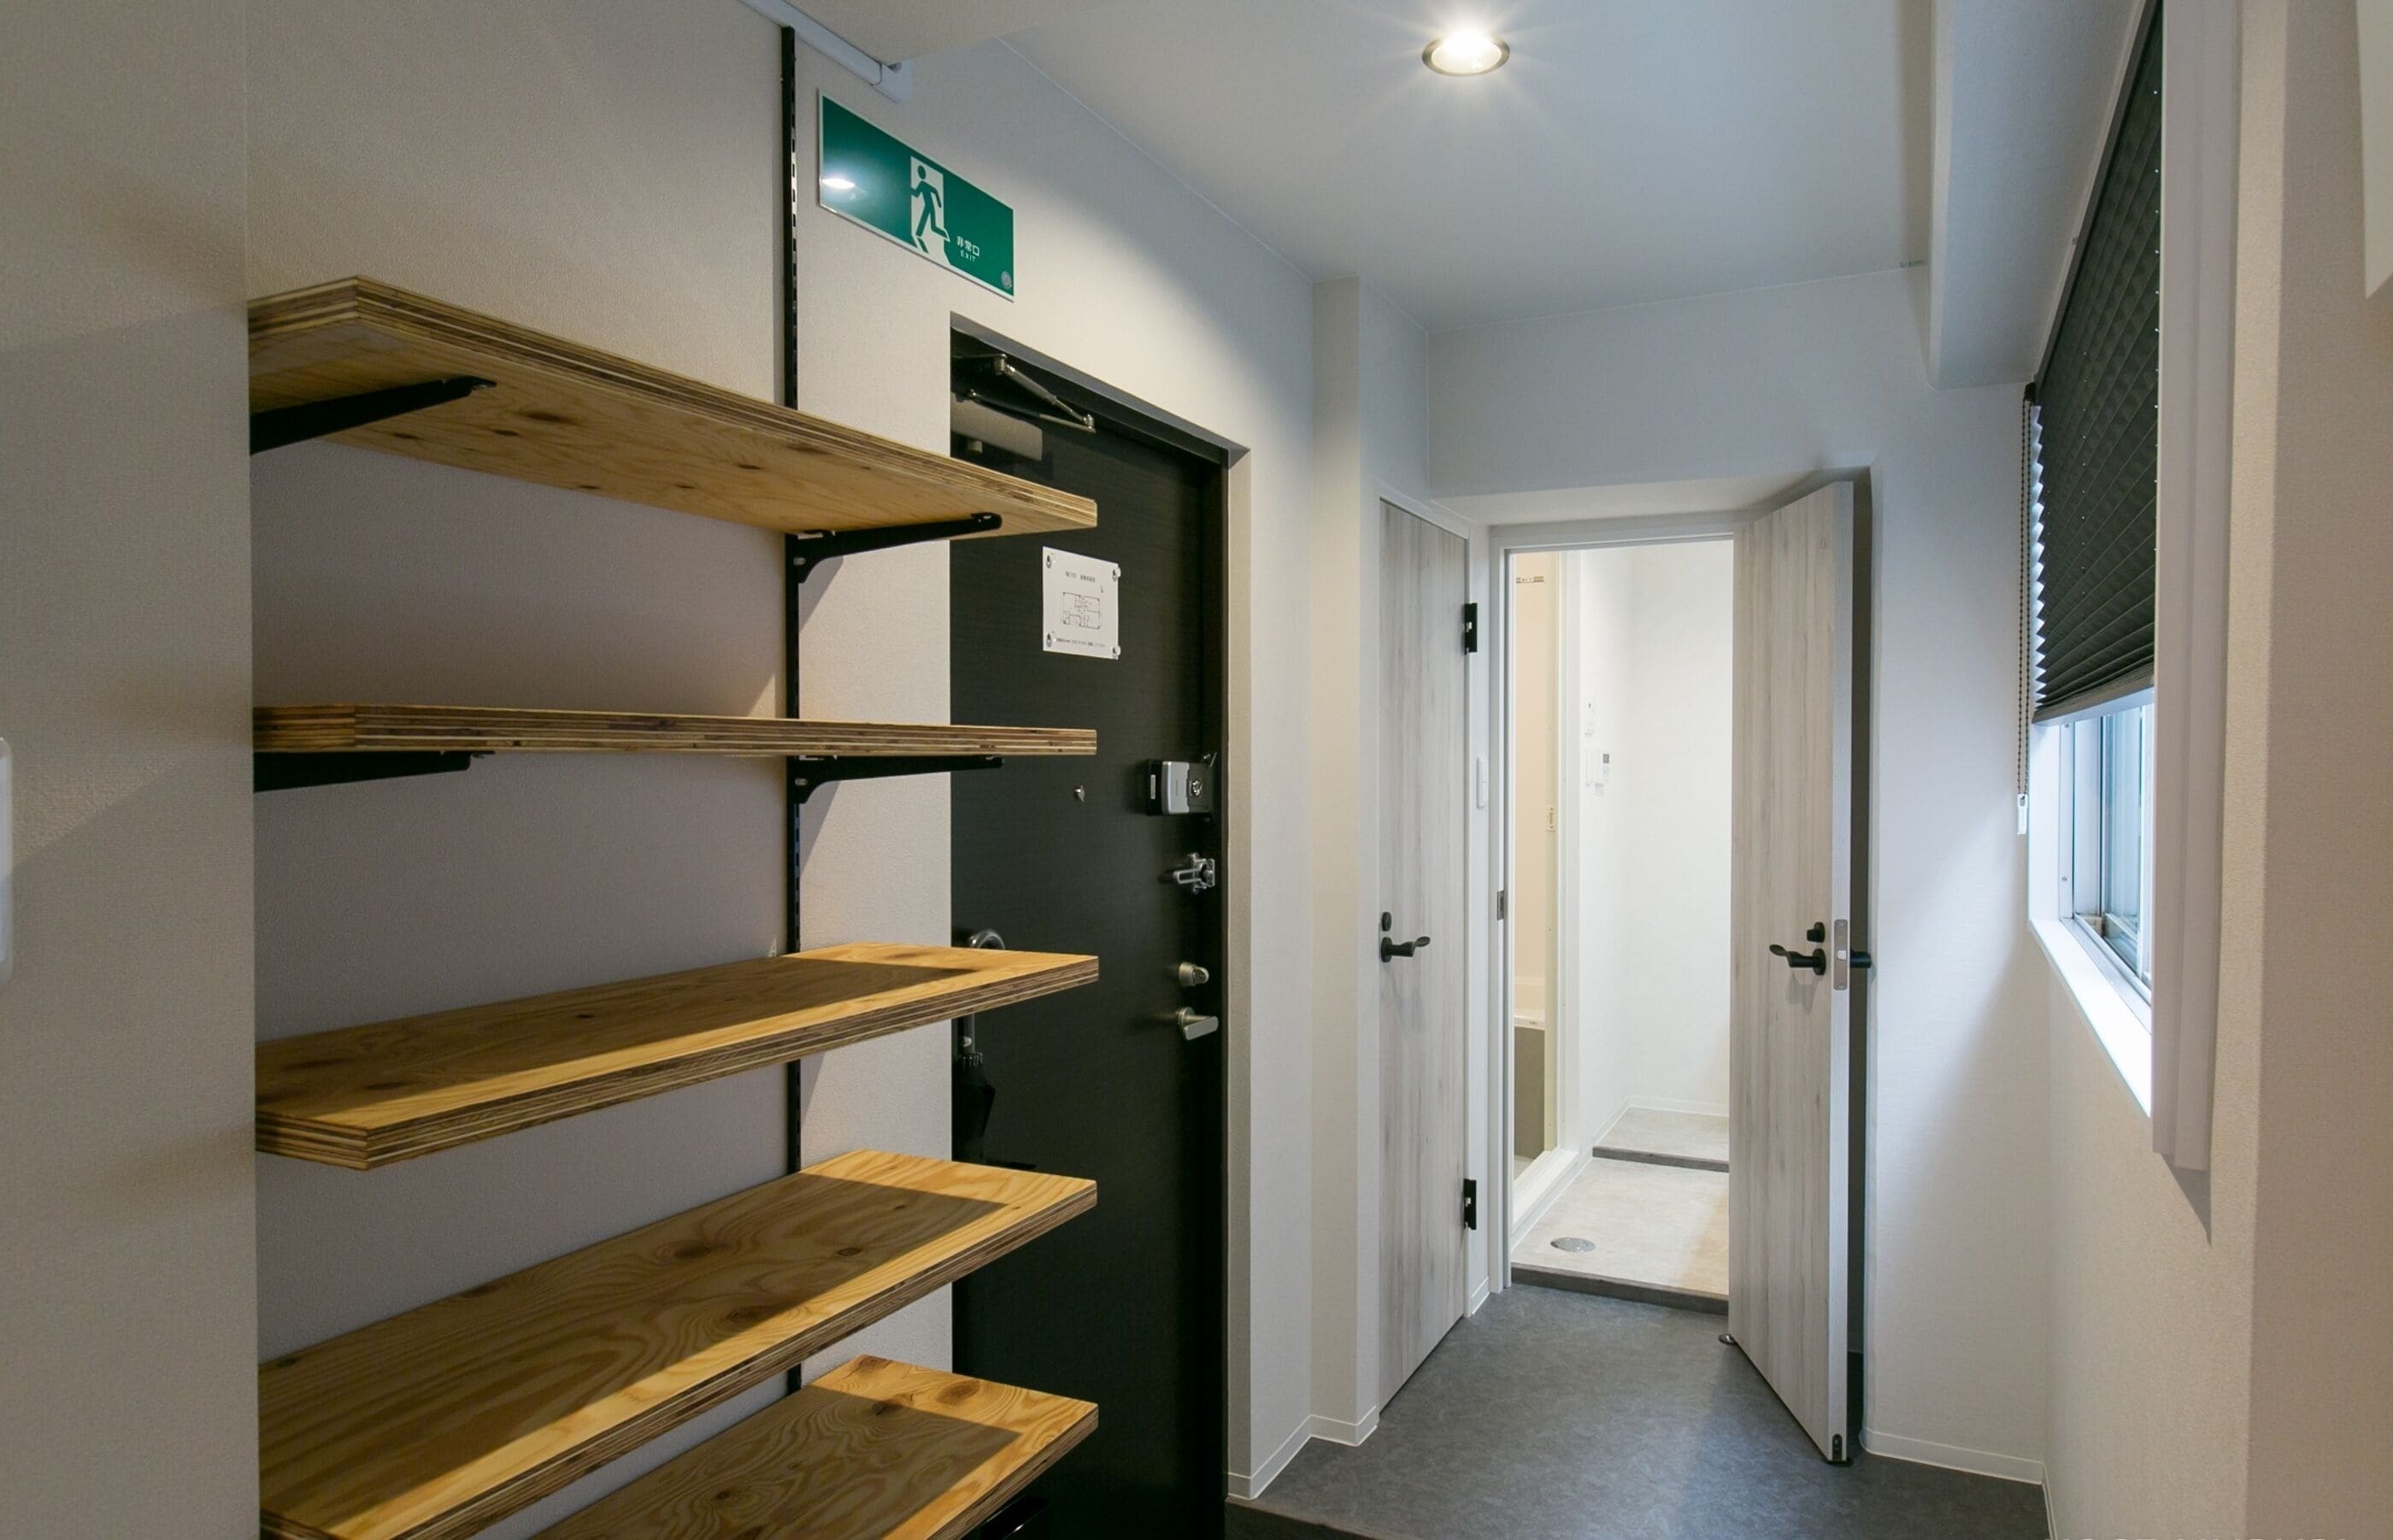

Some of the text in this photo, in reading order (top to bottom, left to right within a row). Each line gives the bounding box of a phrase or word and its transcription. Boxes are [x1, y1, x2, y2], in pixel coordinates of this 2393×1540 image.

[957, 236, 979, 256] 非常口
[961, 250, 975, 262] EXIT
